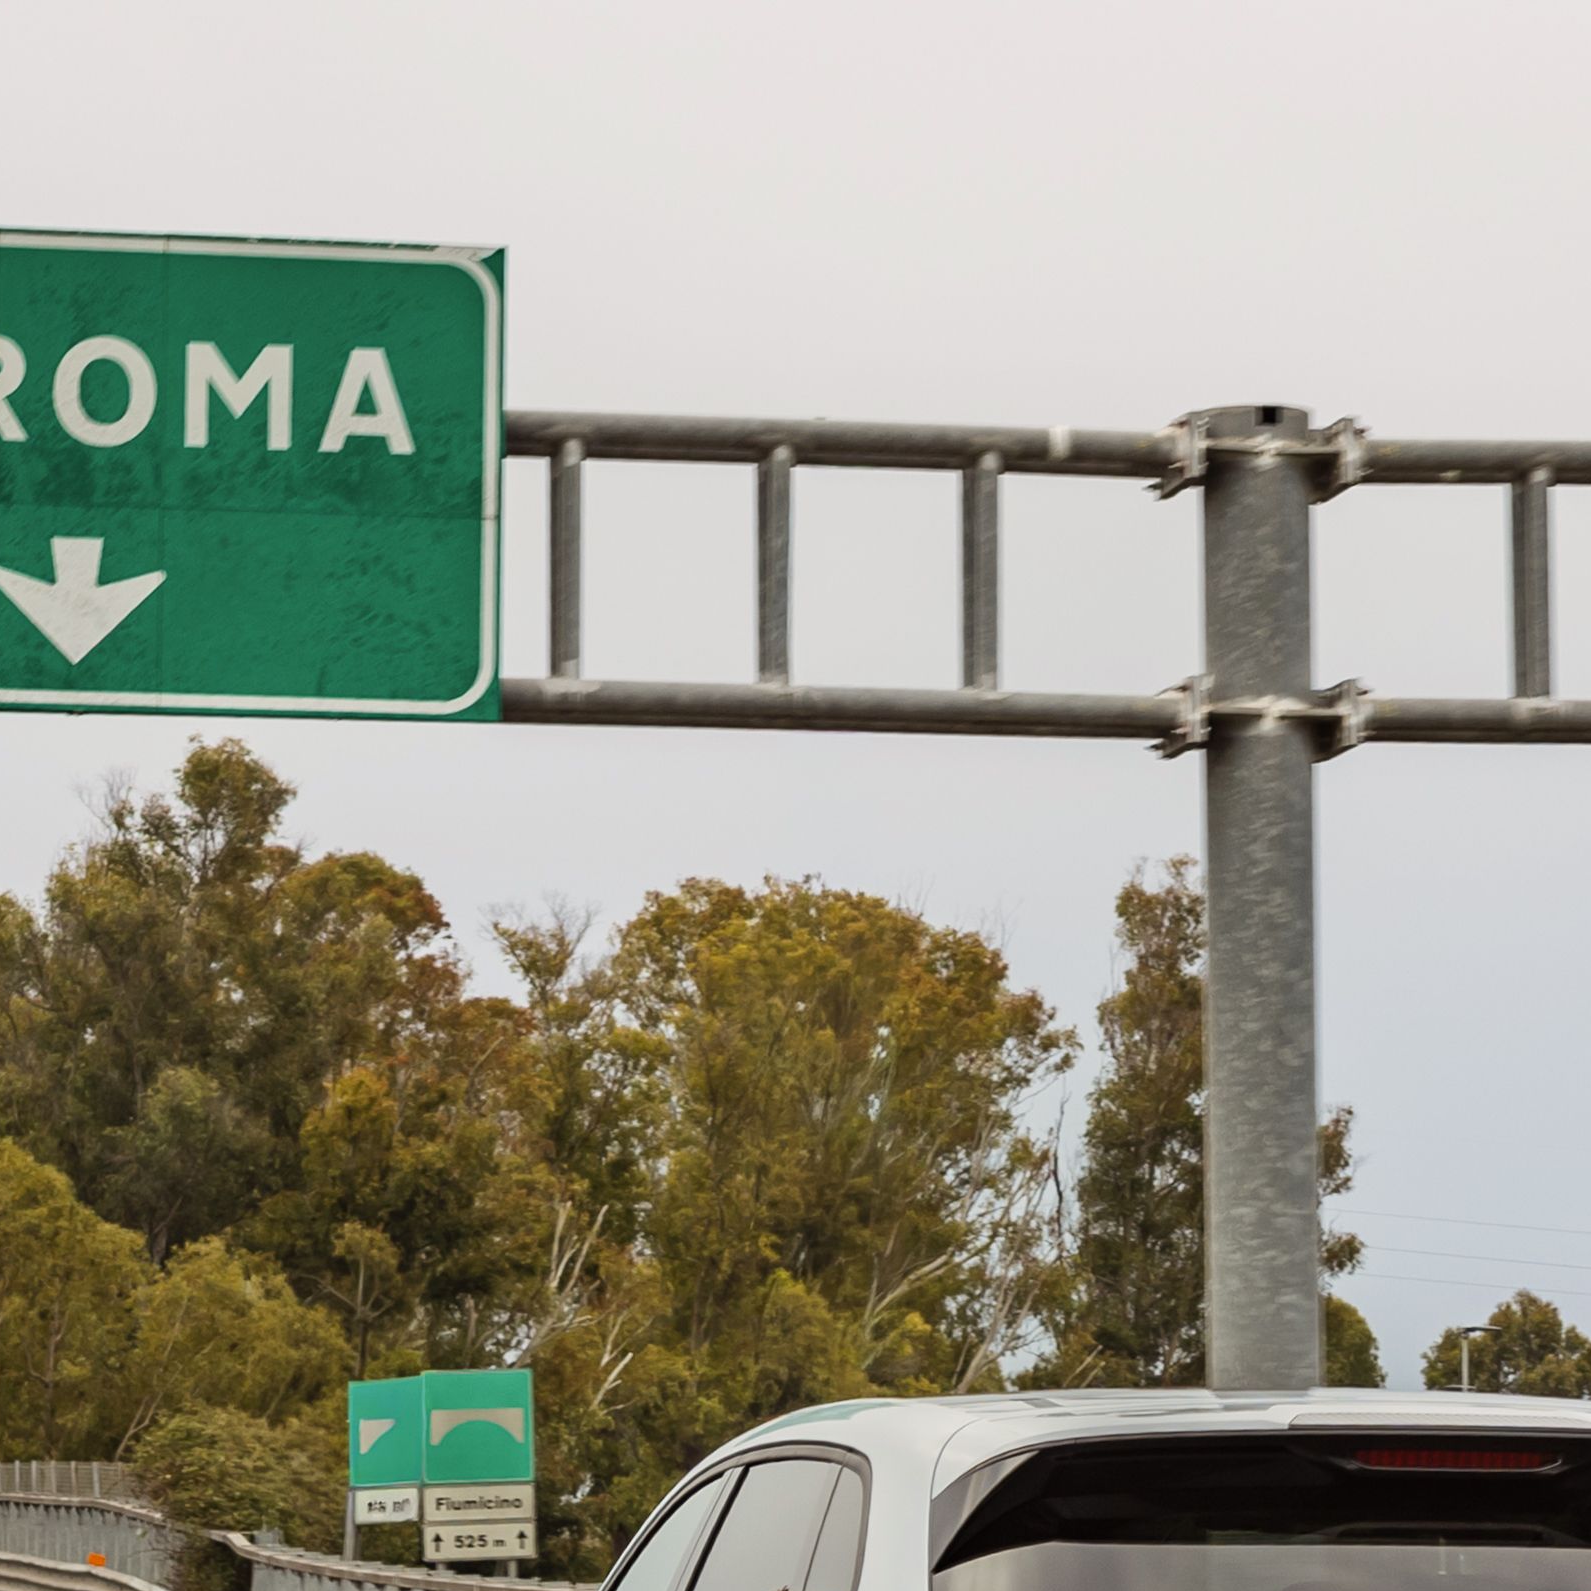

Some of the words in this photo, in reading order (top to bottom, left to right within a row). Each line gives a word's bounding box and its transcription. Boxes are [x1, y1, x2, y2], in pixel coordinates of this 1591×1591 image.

[435, 1495, 523, 1511] Fiumicino
[454, 1534, 488, 1549] 525
[492, 1539, 507, 1548] m
